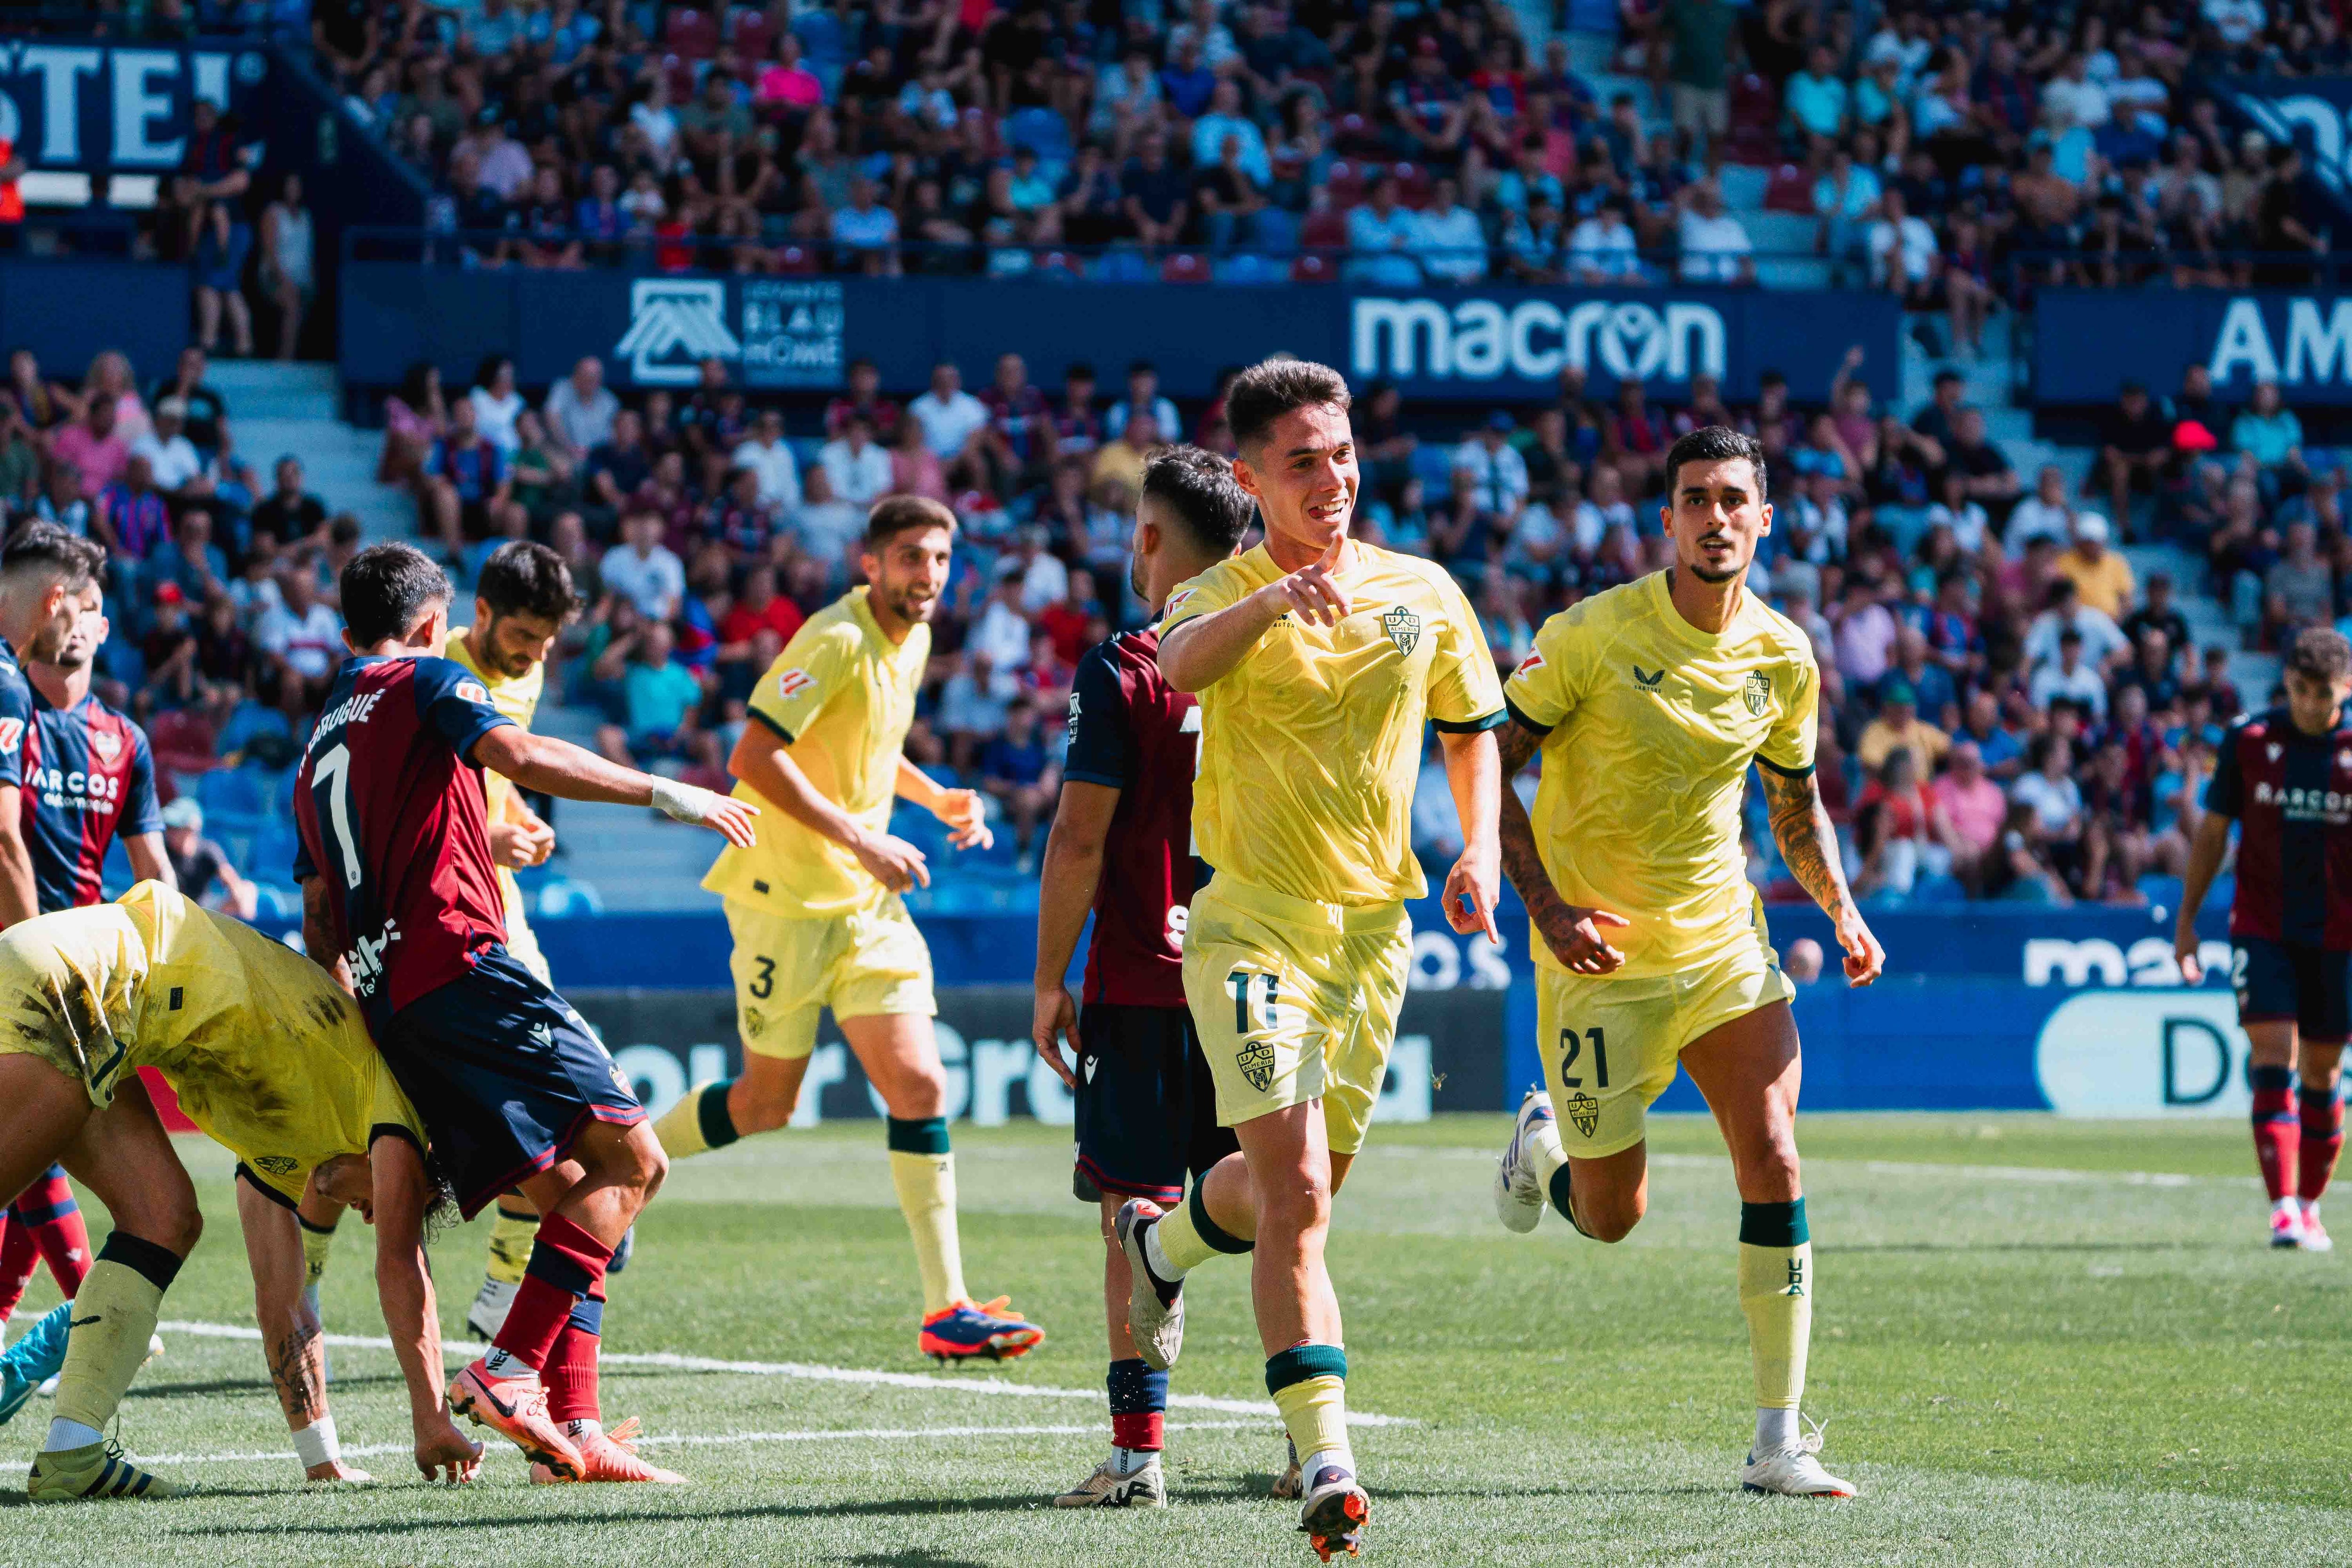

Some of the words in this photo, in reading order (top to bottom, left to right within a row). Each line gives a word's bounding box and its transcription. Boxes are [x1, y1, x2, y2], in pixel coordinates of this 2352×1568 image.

[1352, 297, 1728, 382] macron
[311, 742, 361, 891] 7
[749, 955, 776, 999] 3
[1408, 930, 1512, 991] OS
[1244, 1059, 1272, 1071] ALMERIA
[1560, 1027, 1609, 1088] 21
[1787, 1258, 1804, 1297] UDA
